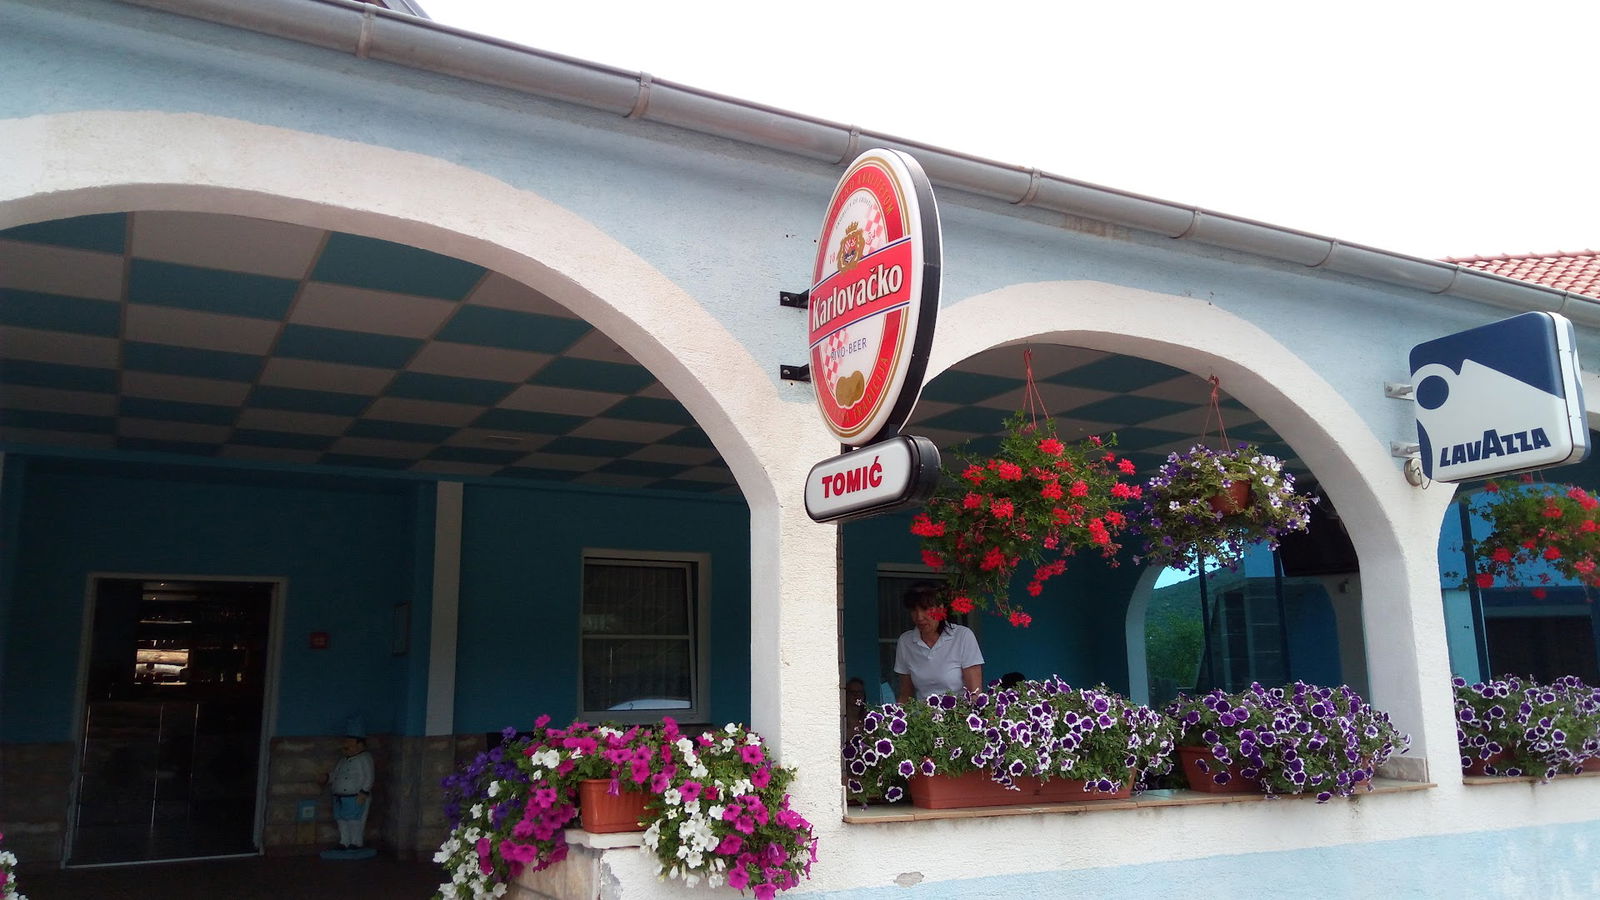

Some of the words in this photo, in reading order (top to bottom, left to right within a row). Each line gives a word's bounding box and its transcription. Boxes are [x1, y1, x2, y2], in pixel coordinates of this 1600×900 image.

[812, 264, 903, 333] Karlovačko
[1439, 427, 1551, 467] LAVAZZA
[822, 455, 882, 498] TOMIĆ
